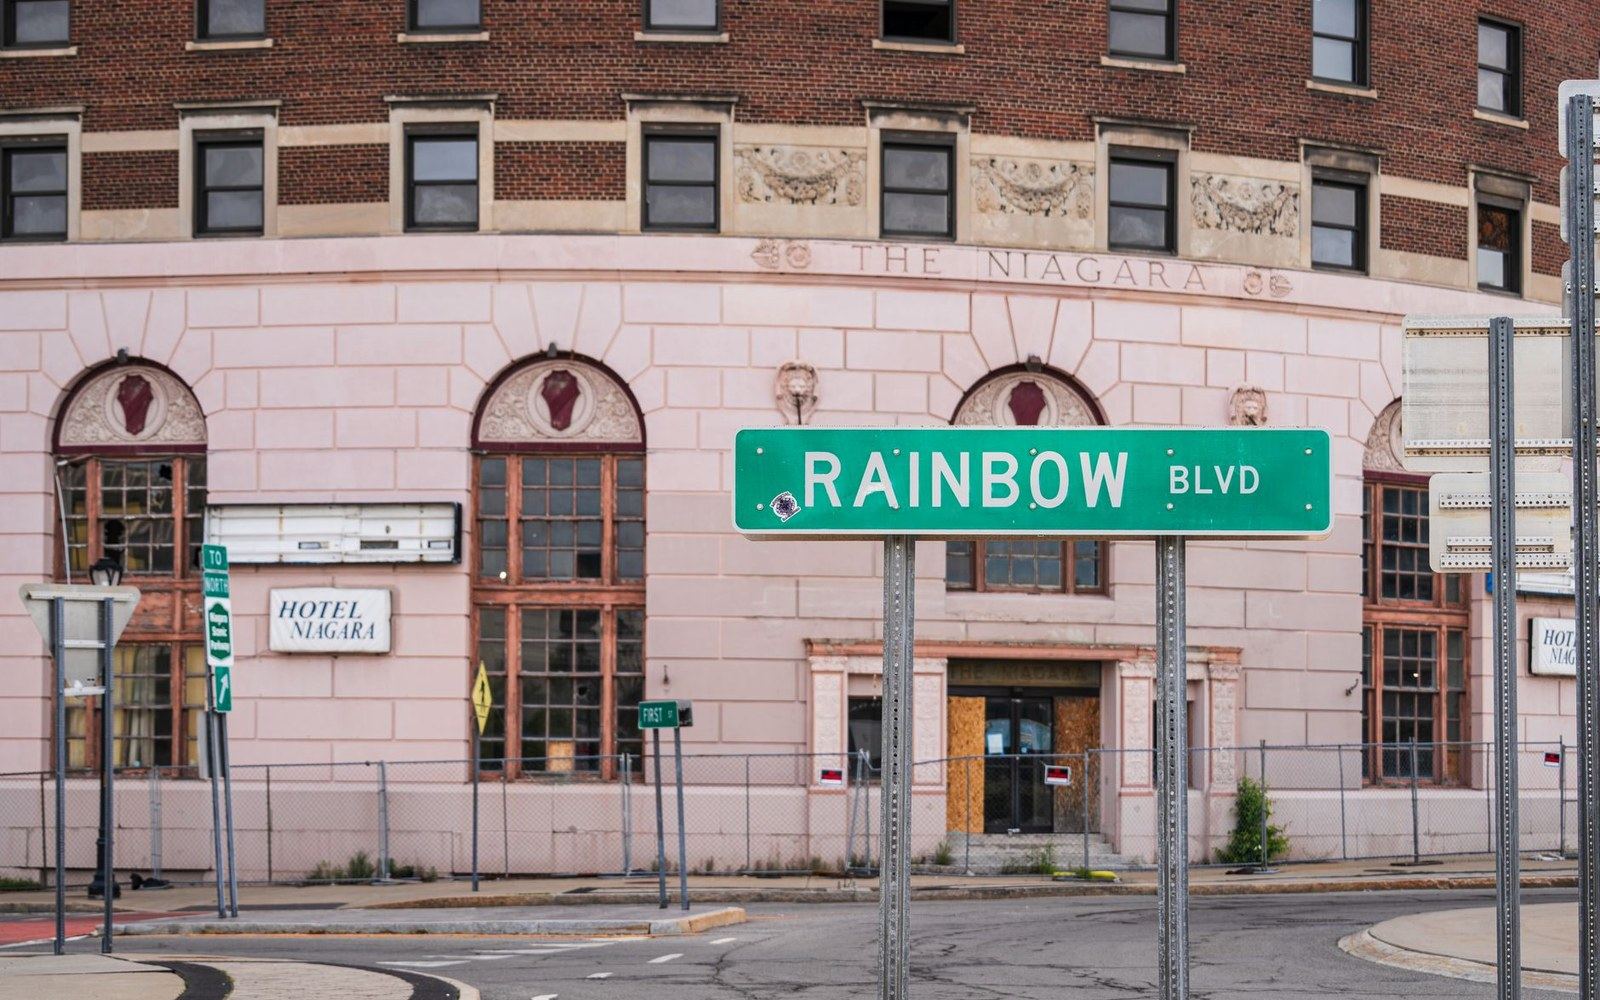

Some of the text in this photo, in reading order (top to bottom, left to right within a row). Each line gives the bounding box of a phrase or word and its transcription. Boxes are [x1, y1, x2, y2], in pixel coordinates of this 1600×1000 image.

[852, 244, 1206, 290] THE NIAGARA
[804, 450, 1129, 510] RAINBOW
[1168, 464, 1260, 495] BLVD
[209, 550, 222, 565] TO
[205, 577, 229, 593] NORTH
[279, 600, 362, 619] HOTEL
[290, 620, 375, 640] NIAGARA
